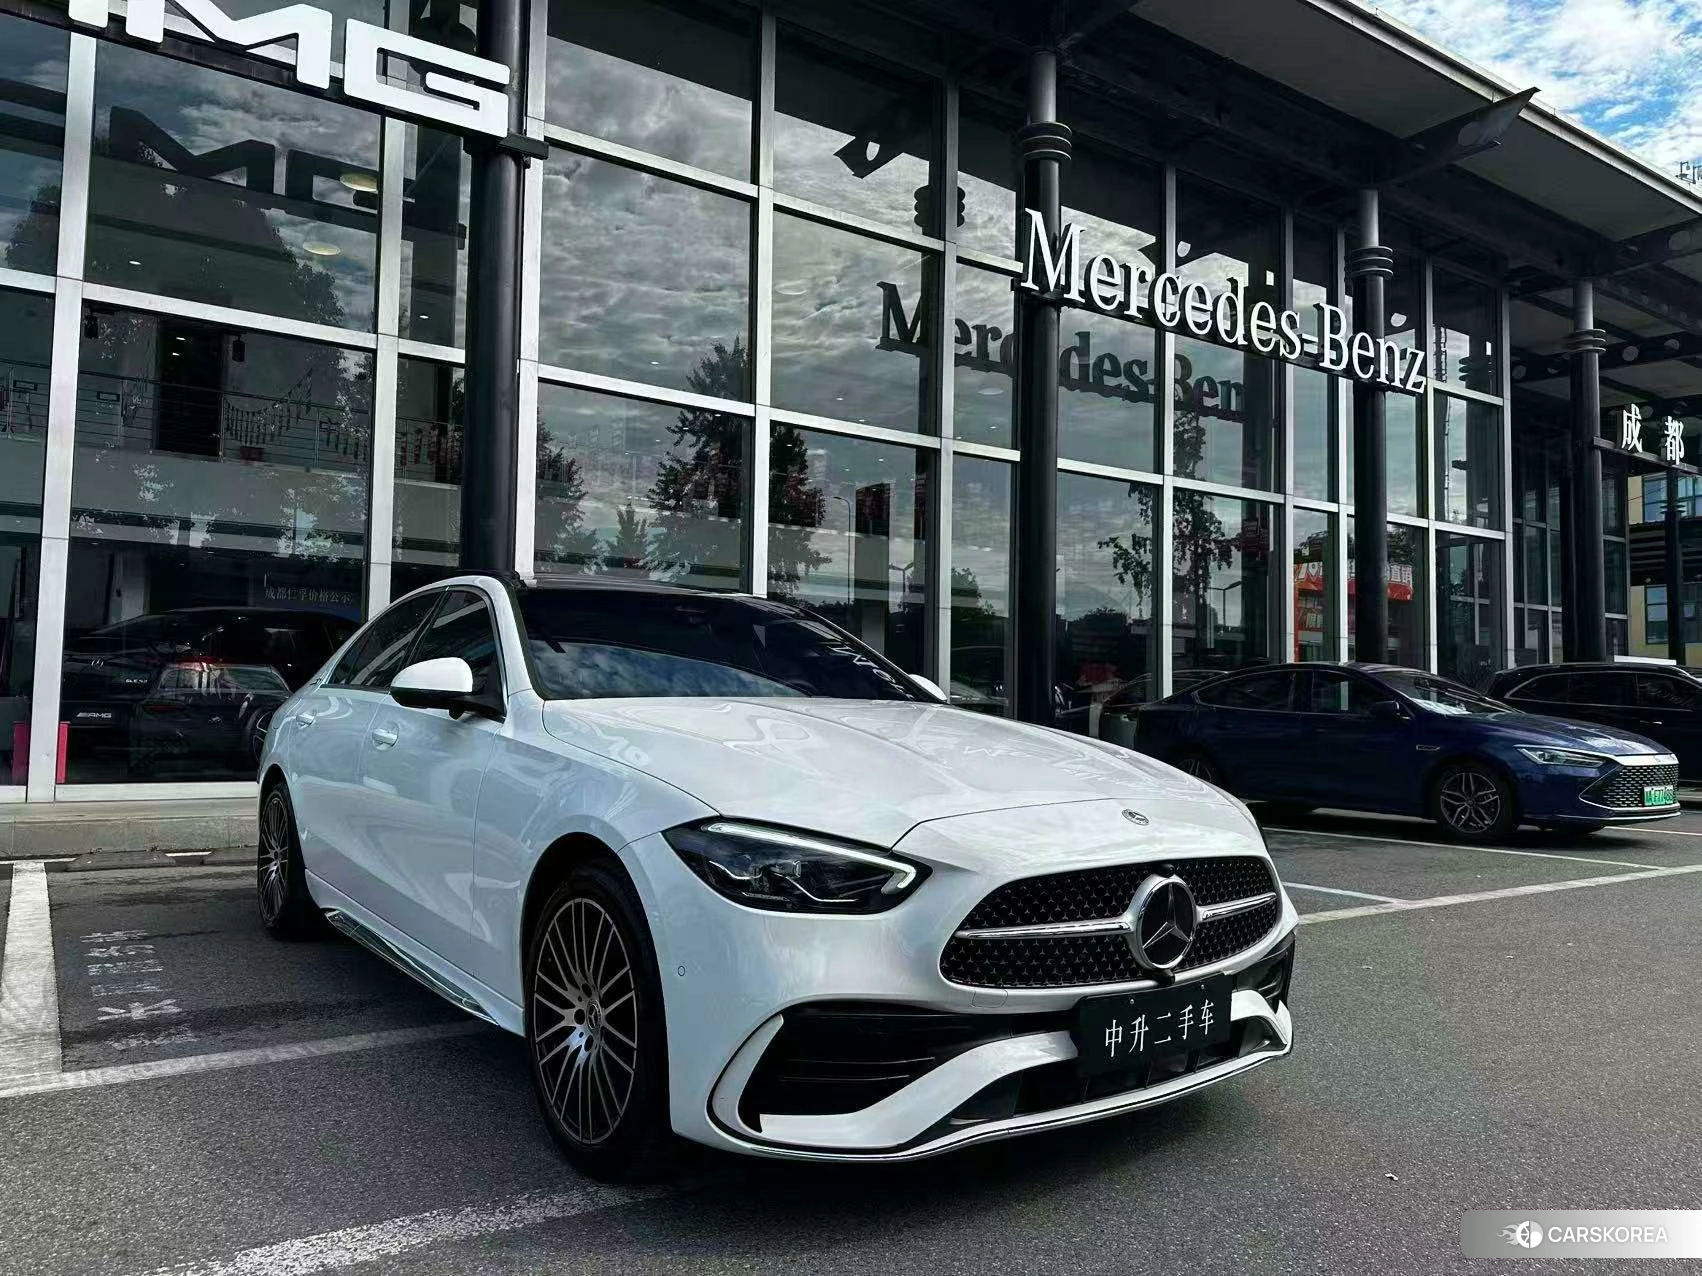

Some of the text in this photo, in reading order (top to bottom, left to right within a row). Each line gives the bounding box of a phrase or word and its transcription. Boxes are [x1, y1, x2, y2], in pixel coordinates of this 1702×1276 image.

[68, 0, 508, 136] MG
[1021, 207, 1427, 394] Mercedes-Benz
[1621, 403, 1685, 465] 成都
[1105, 1000, 1214, 1057] 中升二手车
